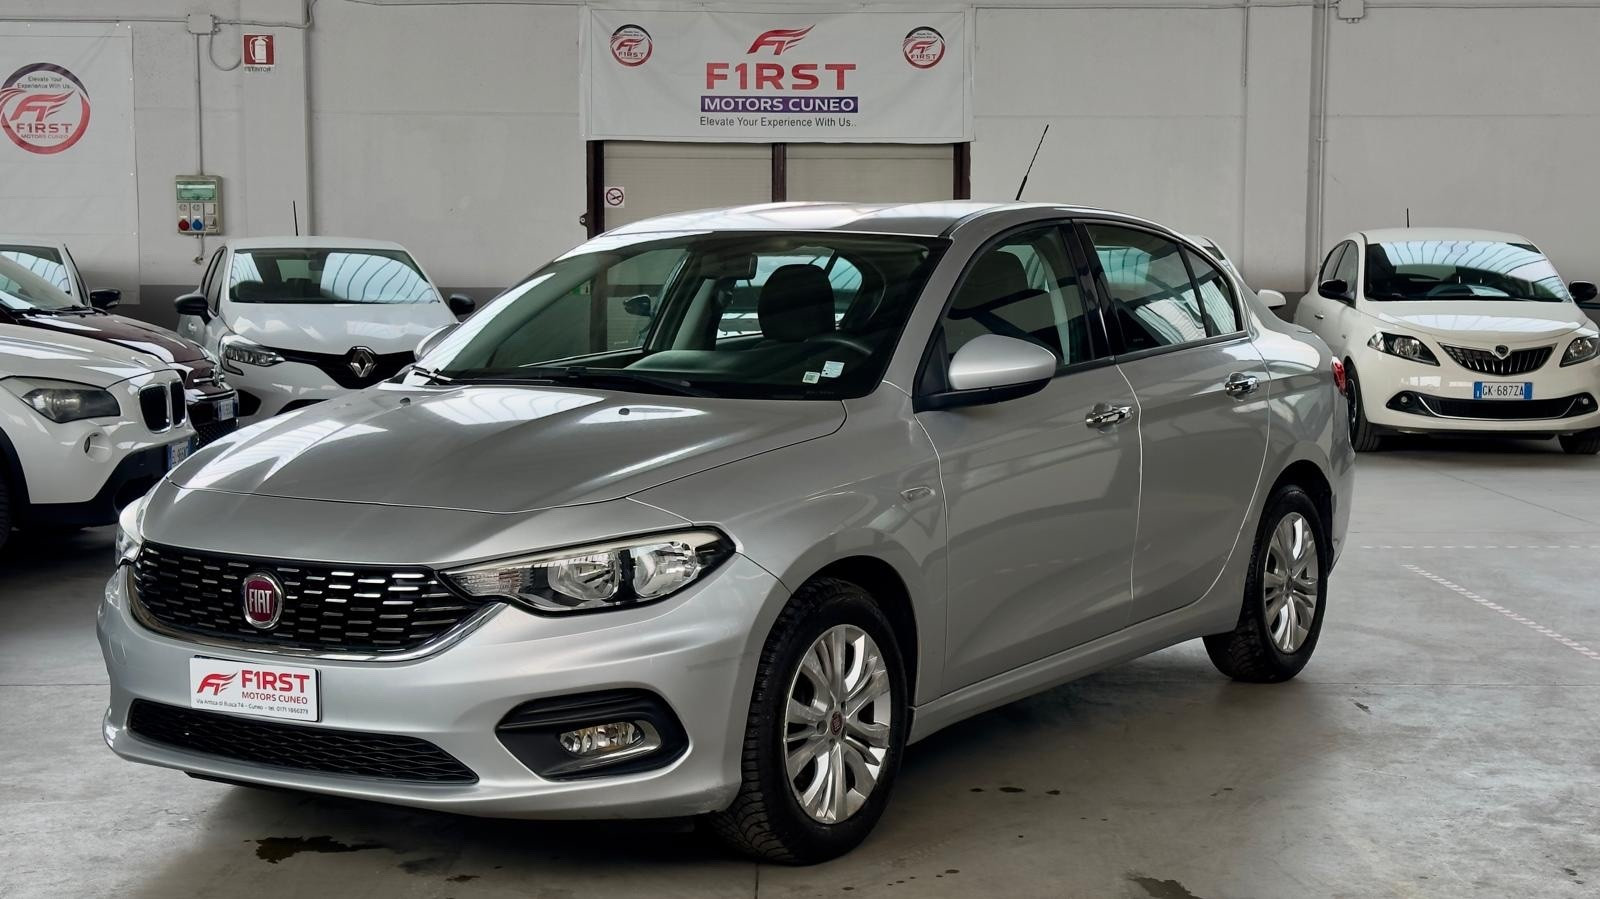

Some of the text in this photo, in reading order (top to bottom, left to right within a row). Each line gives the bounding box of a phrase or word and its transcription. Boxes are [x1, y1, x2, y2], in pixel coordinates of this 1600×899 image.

[706, 62, 857, 90] F1RST
[704, 98, 855, 112] MOTORS CUNEO
[16, 123, 73, 134] F1RST
[700, 116, 735, 127] Elevate
[737, 116, 758, 127] Your
[760, 116, 813, 129] Experience
[814, 117, 836, 127] With
[1482, 385, 1524, 396] GK 687ZA
[249, 588, 272, 614] FIAT
[241, 669, 310, 694] F1RST
[242, 691, 308, 704] MOTORS CUNEO
